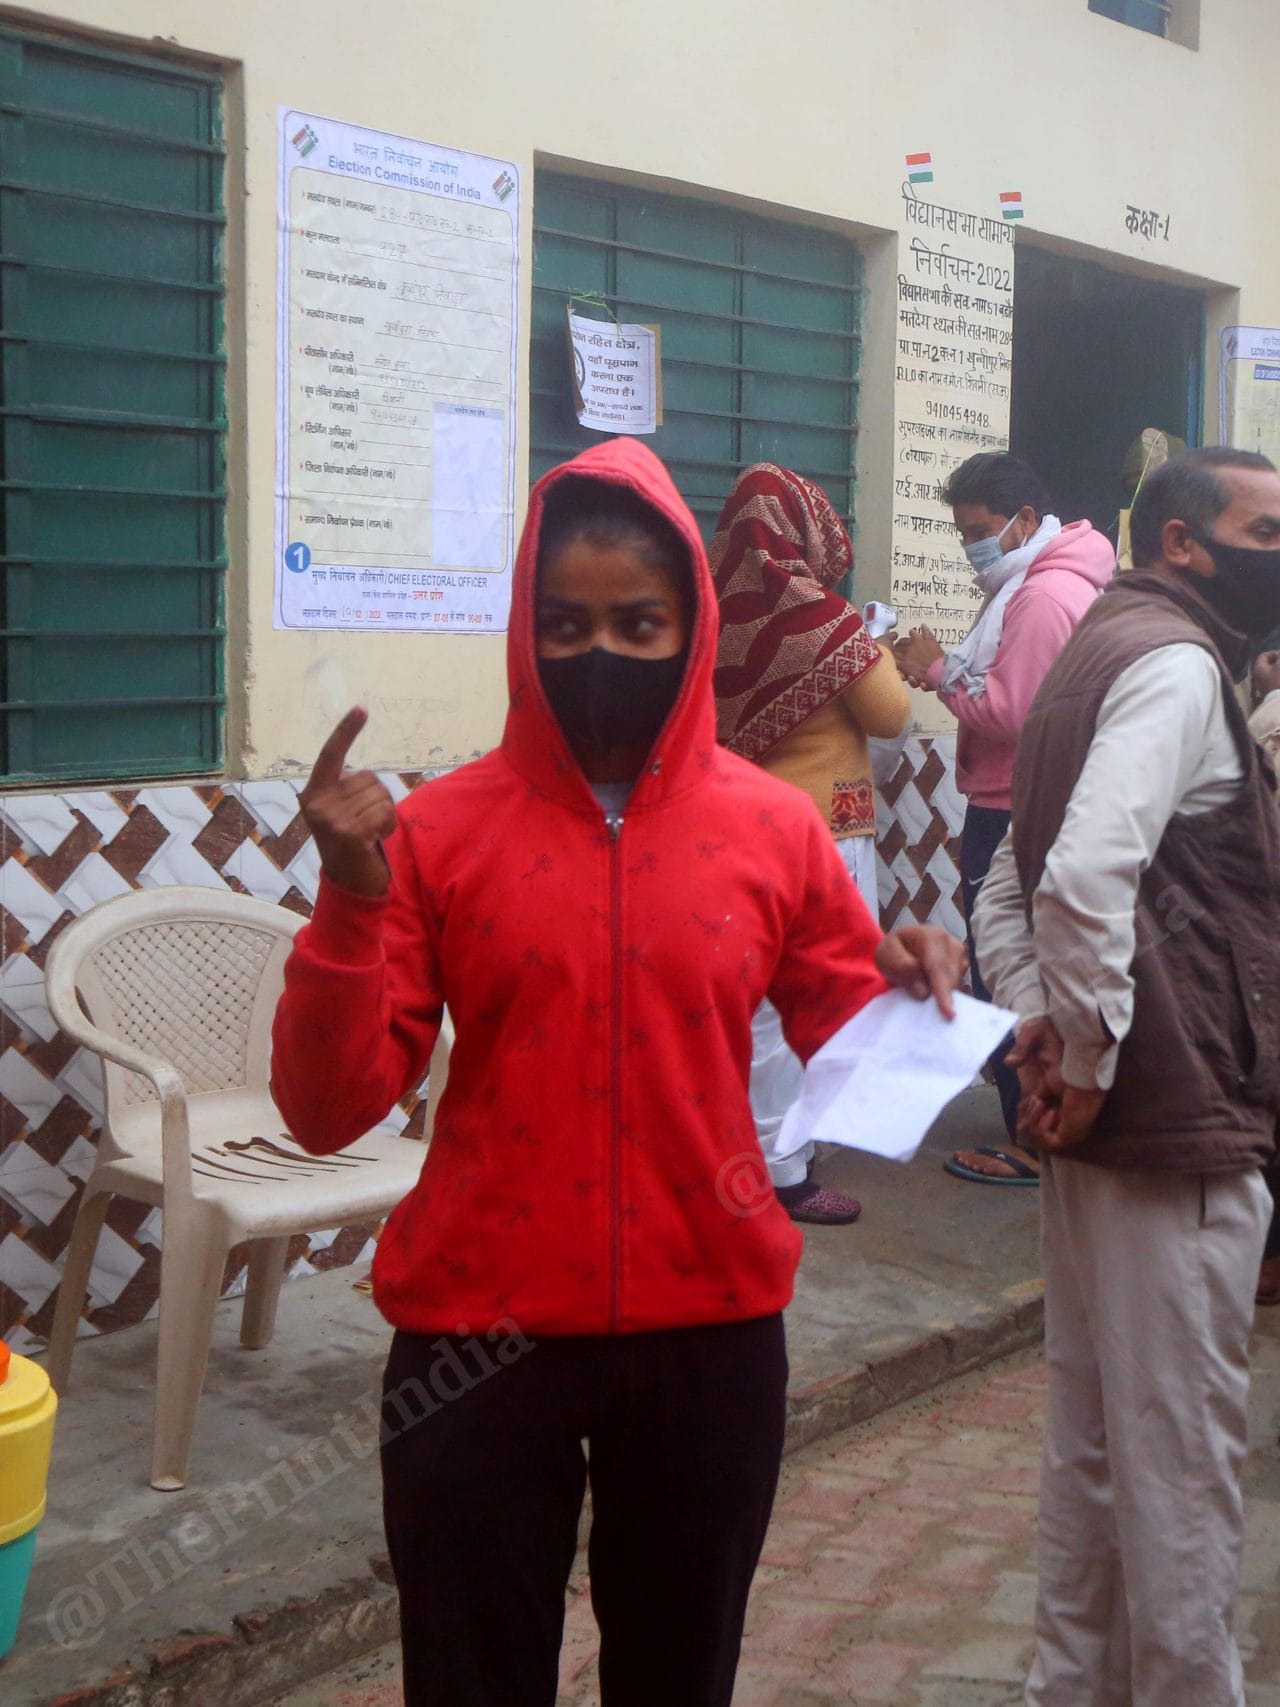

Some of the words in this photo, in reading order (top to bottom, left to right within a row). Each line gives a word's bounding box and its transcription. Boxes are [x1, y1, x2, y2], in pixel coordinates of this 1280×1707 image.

[328, 155, 372, 176] Election
[374, 165, 441, 192] Commission
[443, 182, 455, 195] of
[456, 183, 482, 200] India
[1125, 204, 1170, 241] कक्षा-1
[588, 334, 612, 348] रहित
[591, 370, 614, 381] करना
[616, 374, 635, 382] एक
[293, 546, 305, 569] 1
[412, 574, 457, 587] ELECTORAL
[457, 576, 488, 588] OFFICER
